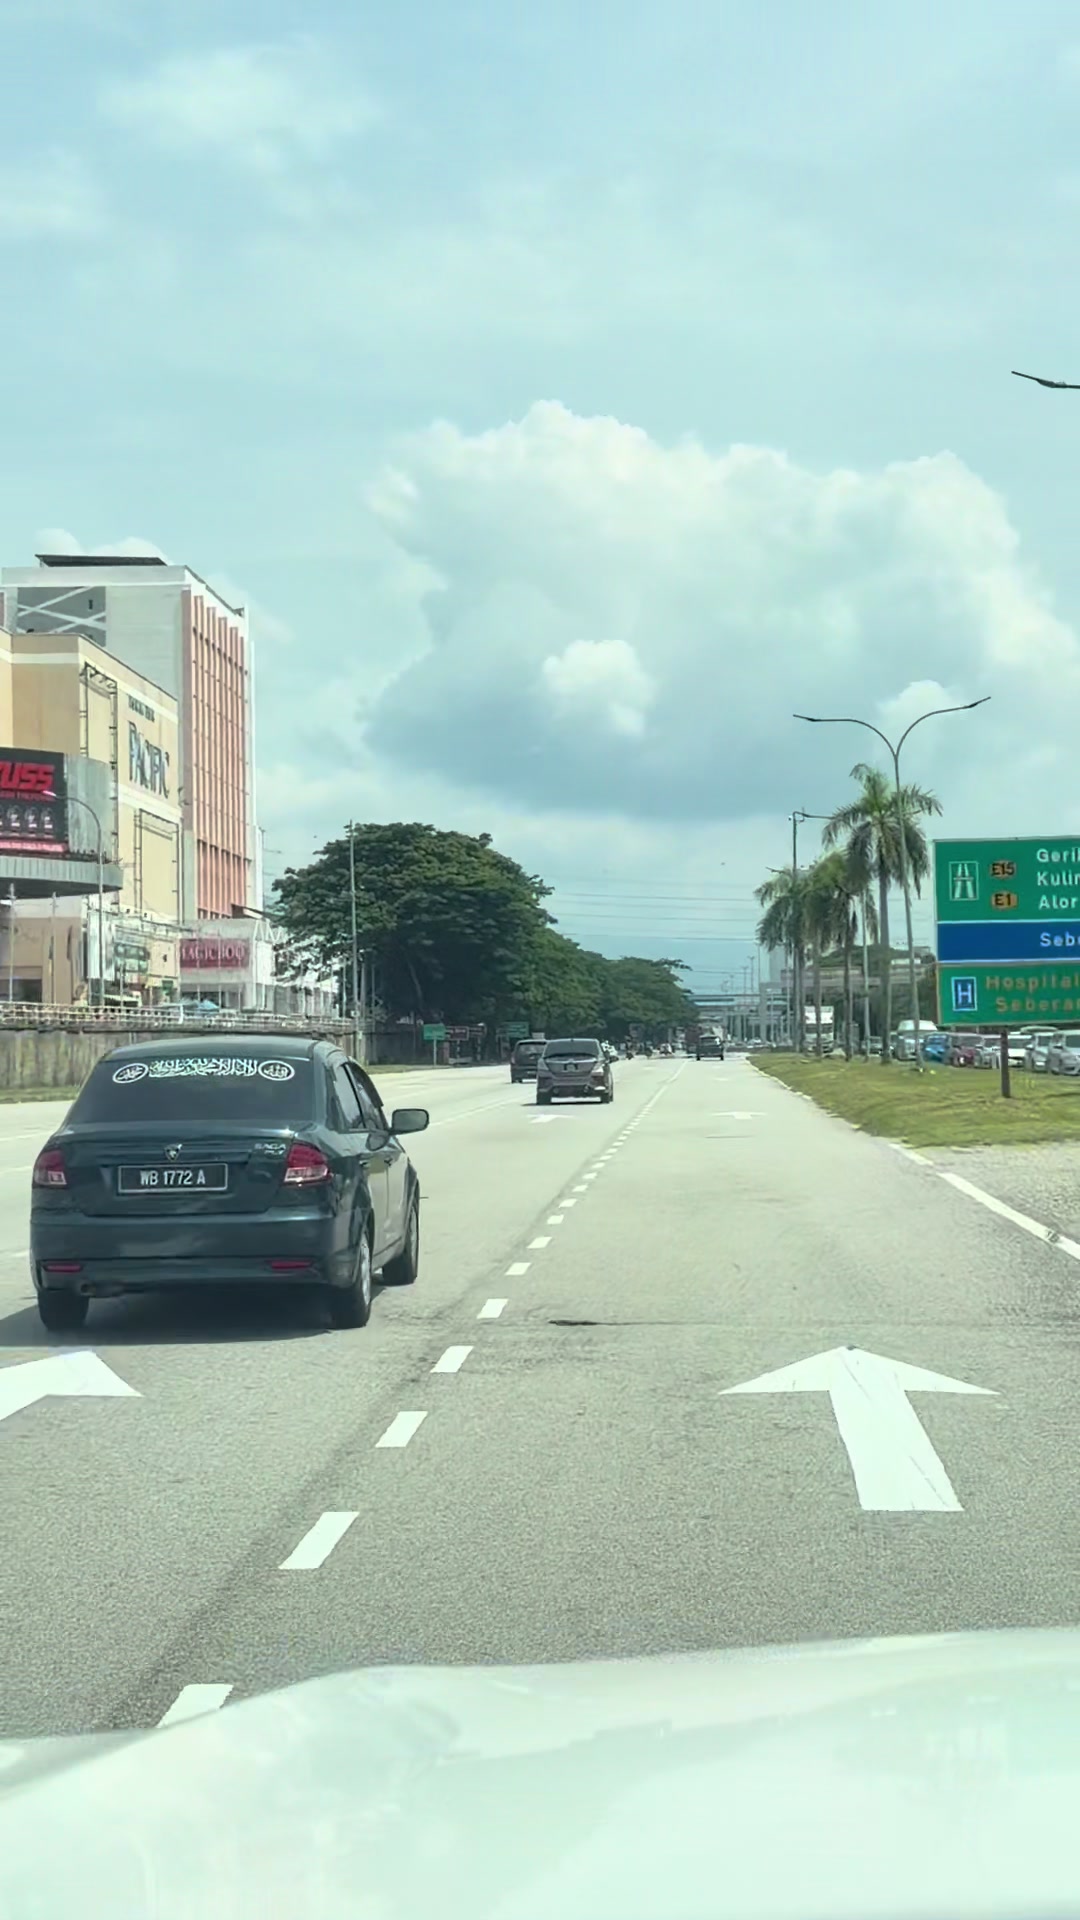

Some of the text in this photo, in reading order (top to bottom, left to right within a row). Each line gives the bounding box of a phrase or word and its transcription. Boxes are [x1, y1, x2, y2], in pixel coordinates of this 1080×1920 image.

[128, 720, 170, 799] PACIFIC
[1036, 847, 1080, 863] Geri
[991, 862, 1015, 876] E15
[994, 893, 1011, 907] E1
[1039, 894, 1078, 910] Alor
[1040, 931, 1080, 947] Seb
[985, 972, 1080, 994] Hospital
[140, 1170, 206, 1185] WB 1772 A
